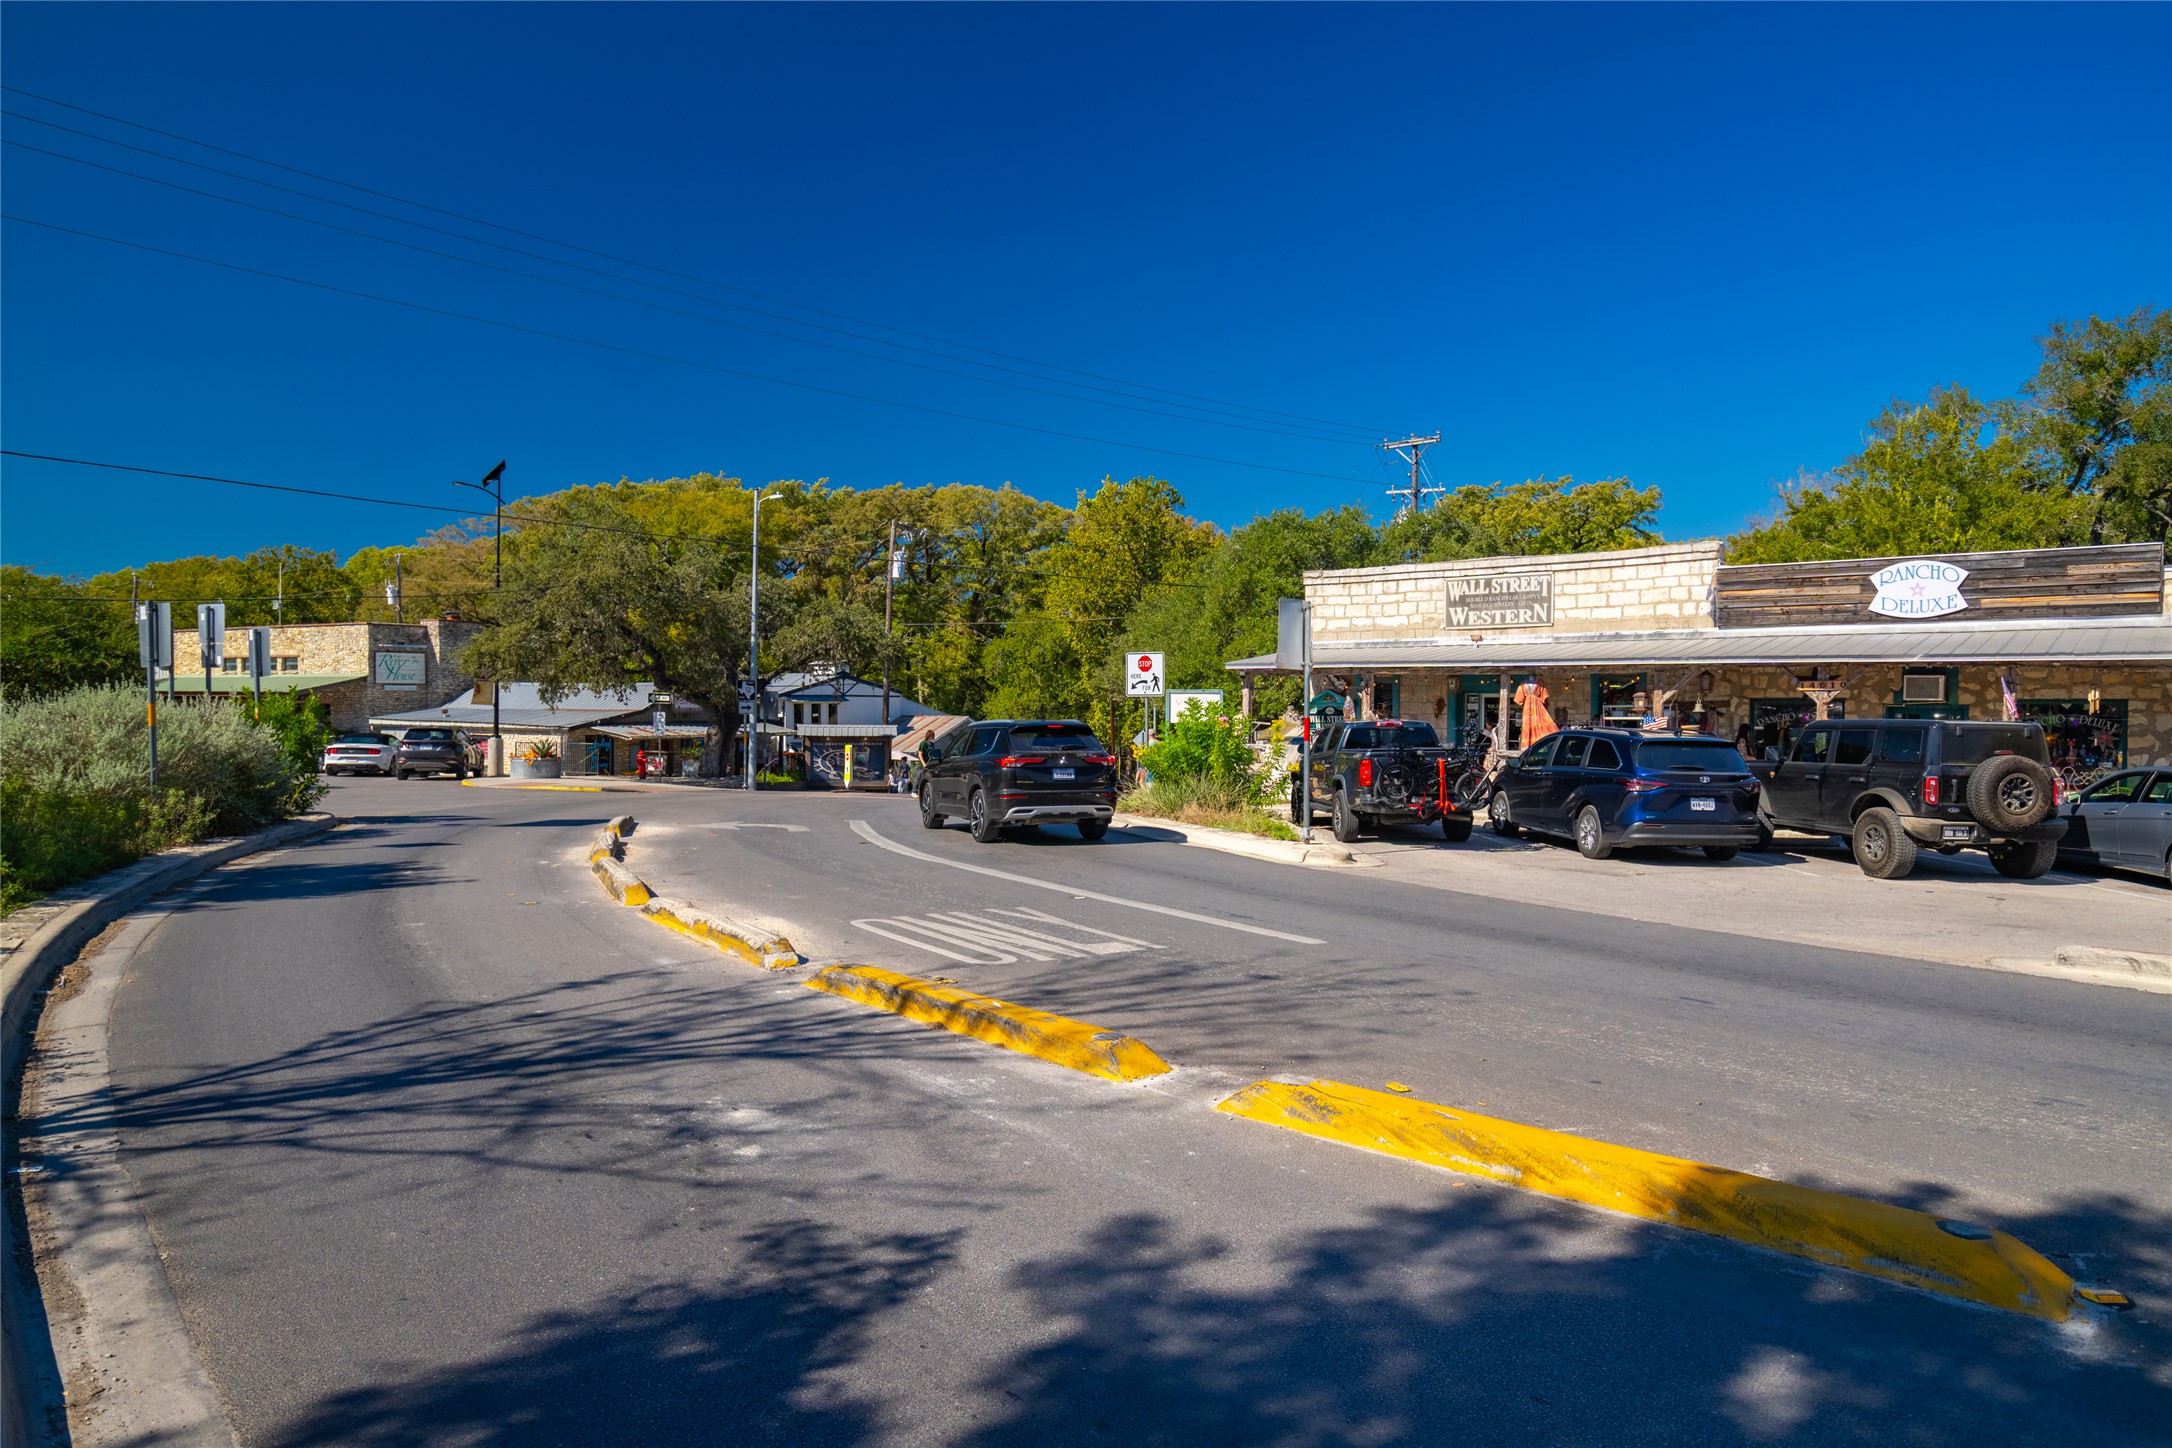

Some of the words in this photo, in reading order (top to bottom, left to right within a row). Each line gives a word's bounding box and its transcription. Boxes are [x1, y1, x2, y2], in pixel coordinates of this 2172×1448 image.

[1880, 564, 1960, 586] RANCHO
[1447, 579, 1490, 602] WALL
[1491, 575, 1551, 596] STREET
[1448, 602, 1549, 626] WESTERN
[1881, 594, 1958, 614] DELUXE
[379, 654, 409, 670] River
[1138, 660, 1152, 668] STOP
[386, 666, 416, 680] House
[2079, 715, 2121, 733] DELUXE
[850, 906, 1168, 965] ONLY
